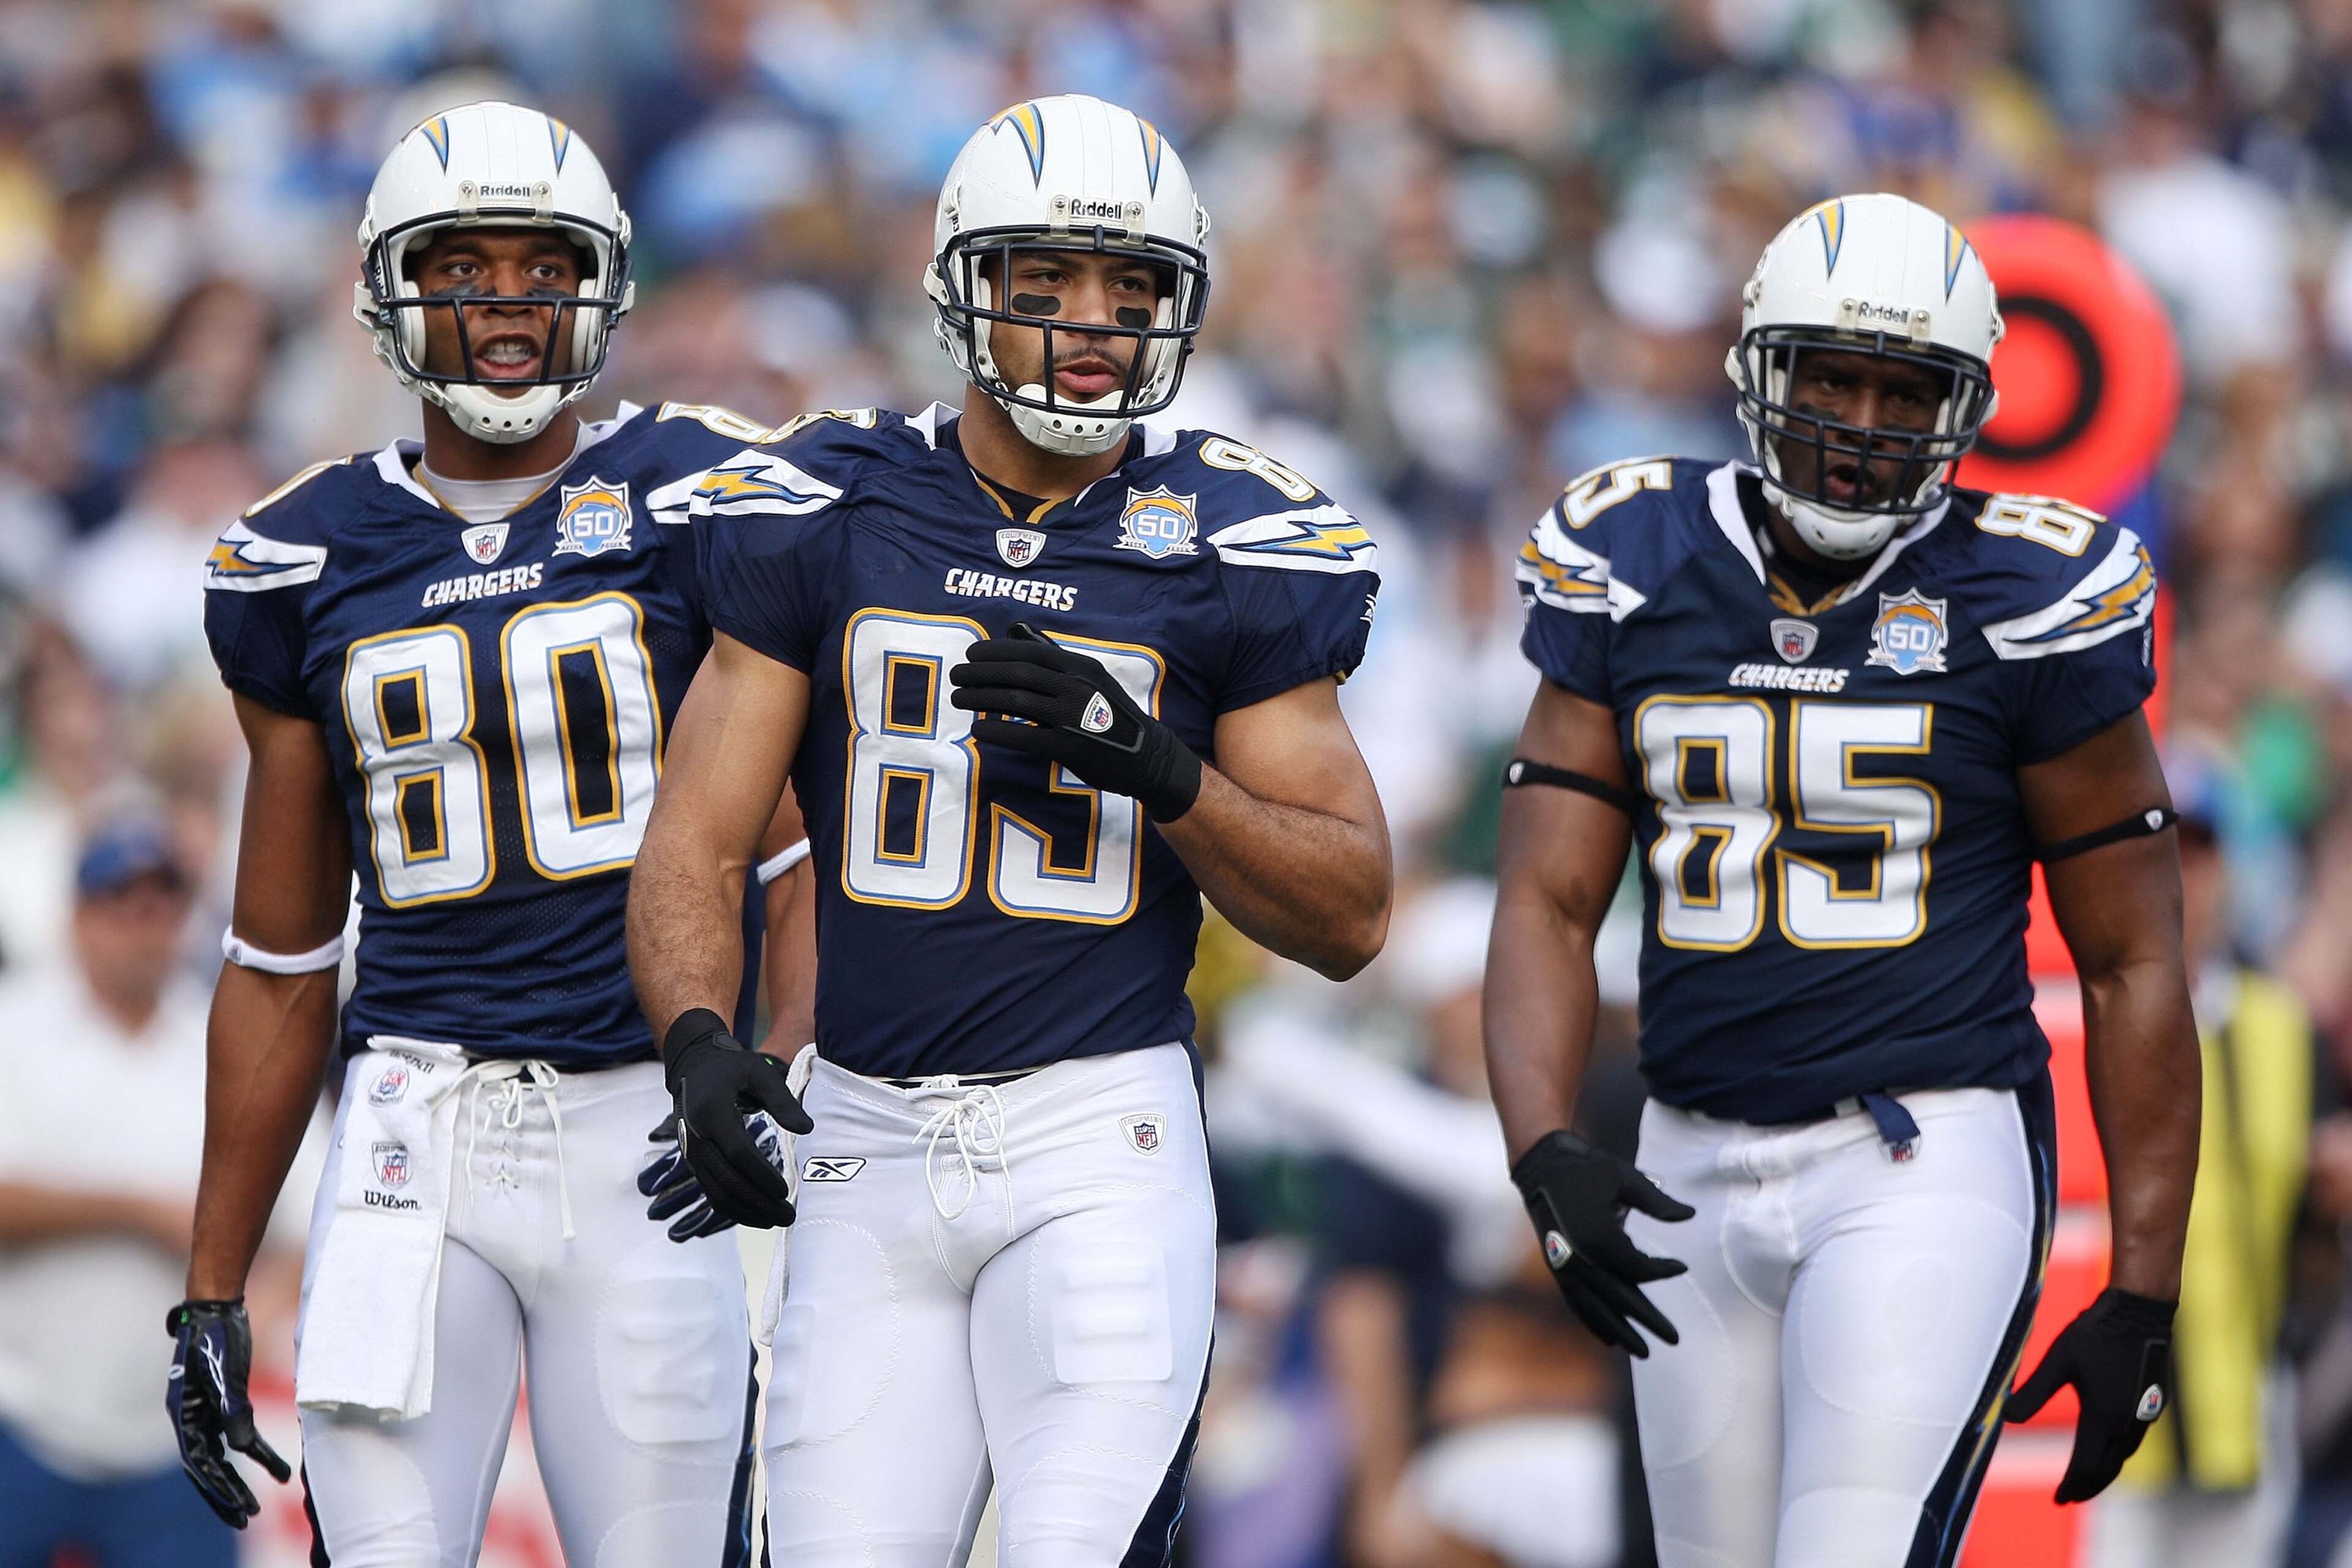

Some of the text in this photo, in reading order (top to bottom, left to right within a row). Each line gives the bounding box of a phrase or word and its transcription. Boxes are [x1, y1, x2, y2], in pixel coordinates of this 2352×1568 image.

[480, 186, 530, 197] Riddell
[1071, 198, 1122, 219] Riddell
[1858, 301, 1909, 324] Riddell
[1199, 437, 1317, 502] 8
[1564, 453, 1672, 530] 5
[574, 511, 614, 538] 50
[1137, 514, 1180, 540] 50
[1974, 492, 2107, 557] 8
[1009, 548, 1027, 559] NFL
[421, 562, 544, 608] CHARGERS
[943, 568, 1078, 611] CHARGERS
[1888, 622, 1930, 652] 50
[1727, 663, 1850, 693] CHARGERS
[341, 590, 662, 909] 80
[841, 607, 1166, 925] 83
[1634, 695, 1941, 953] 85
[1138, 1133, 1156, 1147] NFL
[384, 1166, 404, 1183] NFL
[364, 1189, 418, 1210] Wilson
